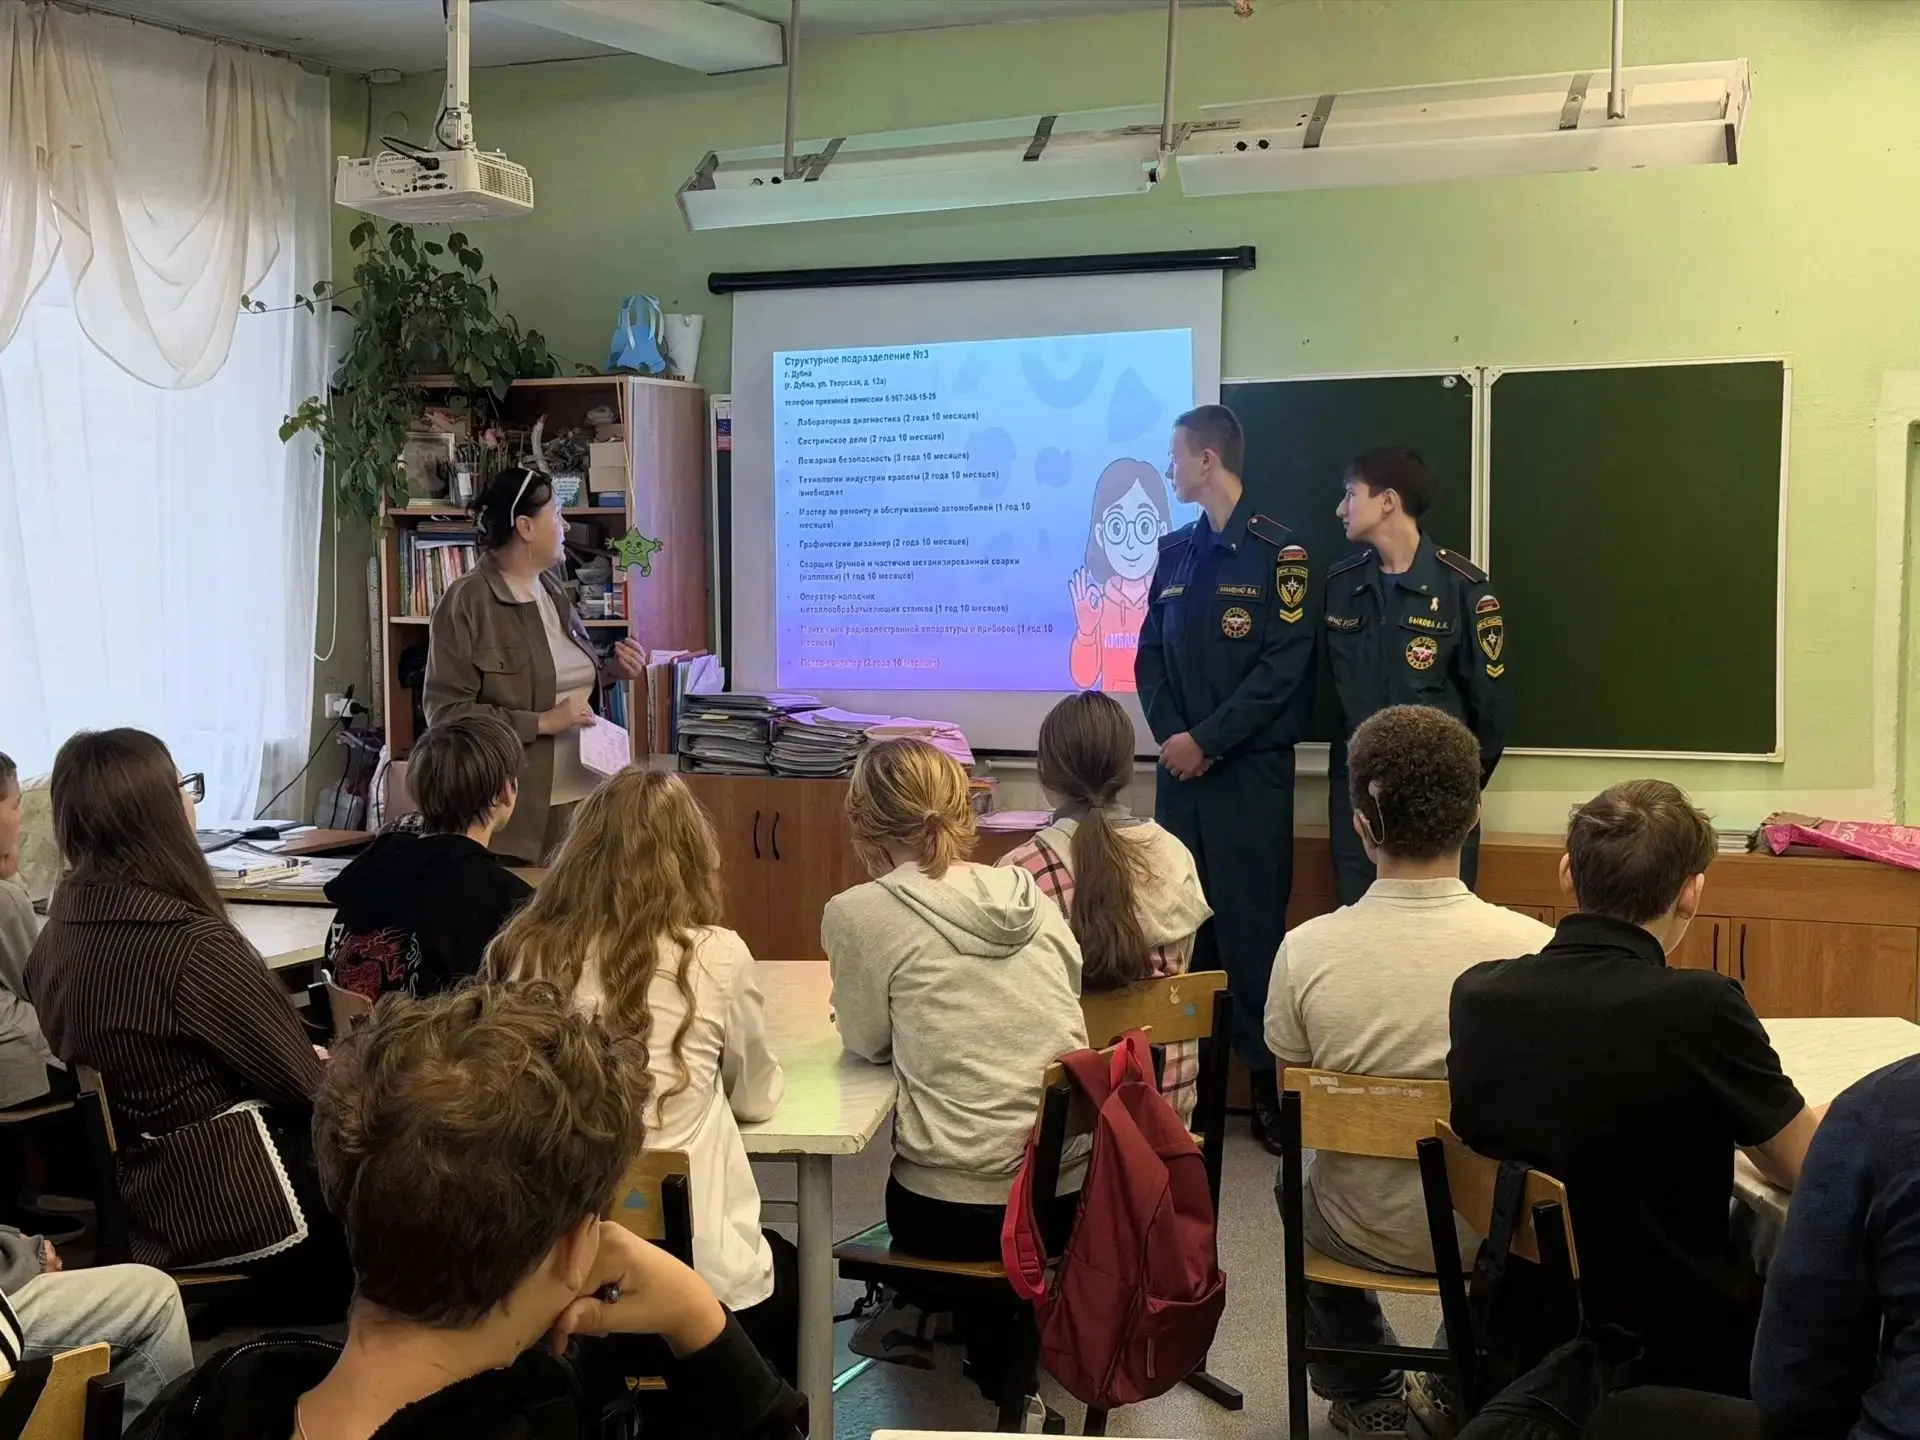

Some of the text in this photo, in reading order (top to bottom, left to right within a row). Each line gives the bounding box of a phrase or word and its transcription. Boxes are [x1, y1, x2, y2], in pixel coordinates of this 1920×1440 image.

[785, 350, 929, 367] Структурное подразделение №3
[791, 370, 812, 379] Дубна
[785, 398, 814, 407] телефон
[850, 395, 884, 404] комиссии
[798, 411, 979, 426] Лабораторная диагностика (2 года 10 месяцев)
[798, 432, 944, 446] Сестринское дело (2 года 10 месяцев)
[798, 451, 969, 465] Пожарная безопасность (3 года 10 месяцев)
[798, 475, 843, 484] Технологии
[845, 475, 886, 484] индустрии
[888, 473, 920, 483] красоты
[922, 472, 929, 482] (2
[952, 471, 960, 479] 10
[963, 470, 999, 480] месяцев)
[799, 507, 827, 516] Мастер
[840, 507, 871, 517] ремонту
[880, 505, 940, 516] обслуживанию
[941, 503, 993, 512] автомобилей
[995, 503, 1003, 512] (1
[1005, 503, 1019, 512] год
[1021, 502, 1031, 511] 10
[799, 521, 834, 530] месяцев)
[799, 537, 969, 550] Графический дизайнер (2 года 10 месяцев)
[799, 559, 834, 569] Сварщик
[835, 559, 866, 569] (ручной
[874, 559, 911, 567] частично
[912, 558, 989, 567] механизированной
[991, 558, 1020, 567] сварки
[799, 571, 914, 583] (наплавки) (1 год 10 месяцев)
[902, 604, 933, 613] станков
[944, 605, 958, 613] год
[960, 604, 969, 612] 10
[971, 603, 1009, 613] месяцев)
[1044, 624, 1053, 633] 10
